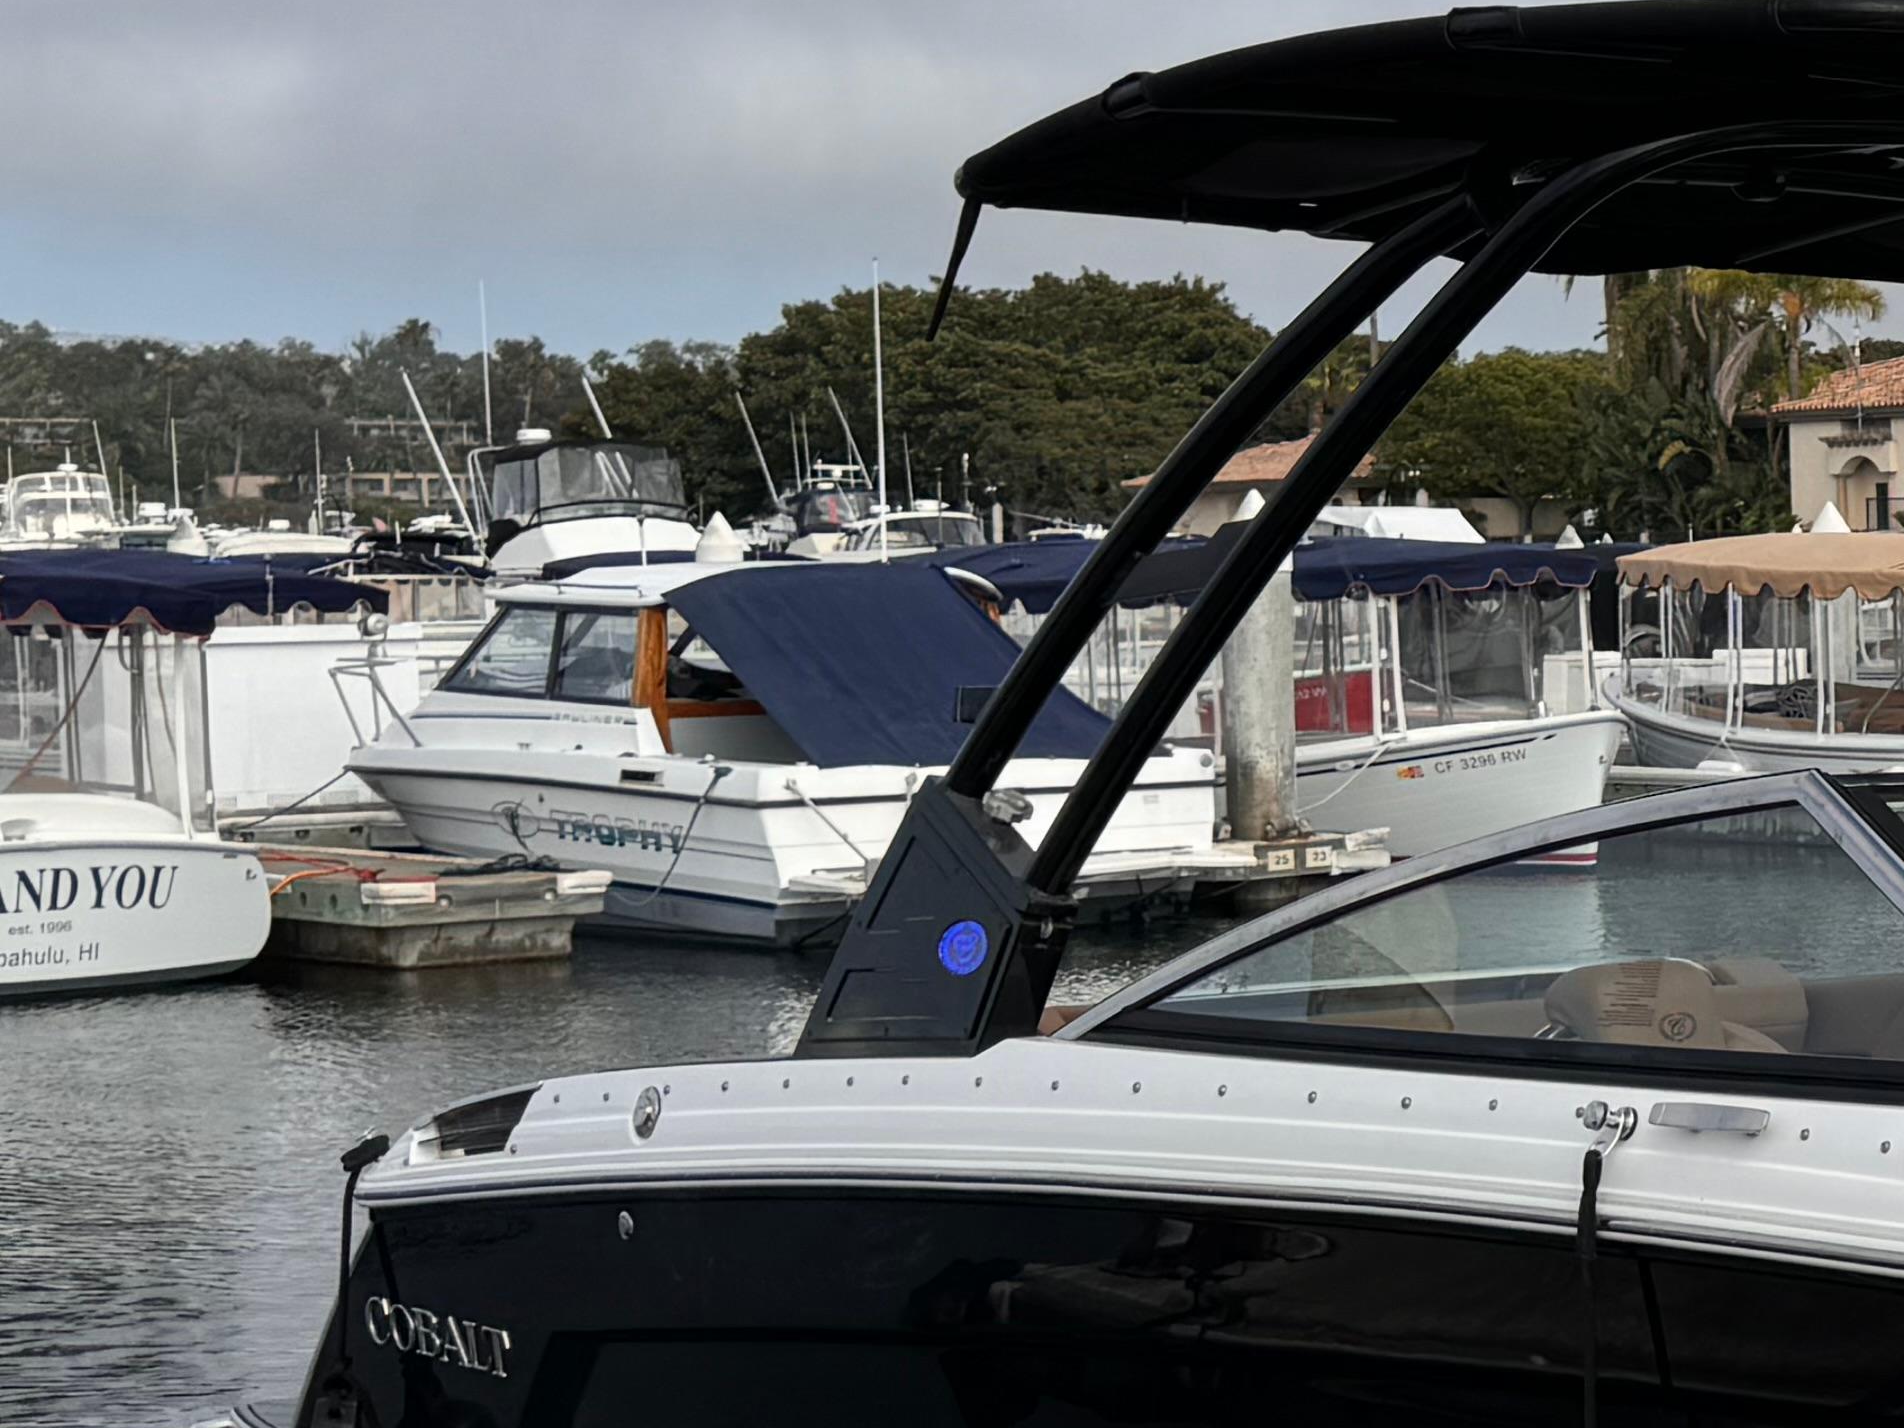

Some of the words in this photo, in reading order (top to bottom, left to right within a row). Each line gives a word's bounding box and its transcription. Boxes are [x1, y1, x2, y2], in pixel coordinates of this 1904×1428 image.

[1434, 761, 1454, 773] CF
[1501, 748, 1527, 763] RW
[89, 864, 179, 910] YOU
[79, 940, 100, 962] HI
[364, 1295, 511, 1379] COBALT
